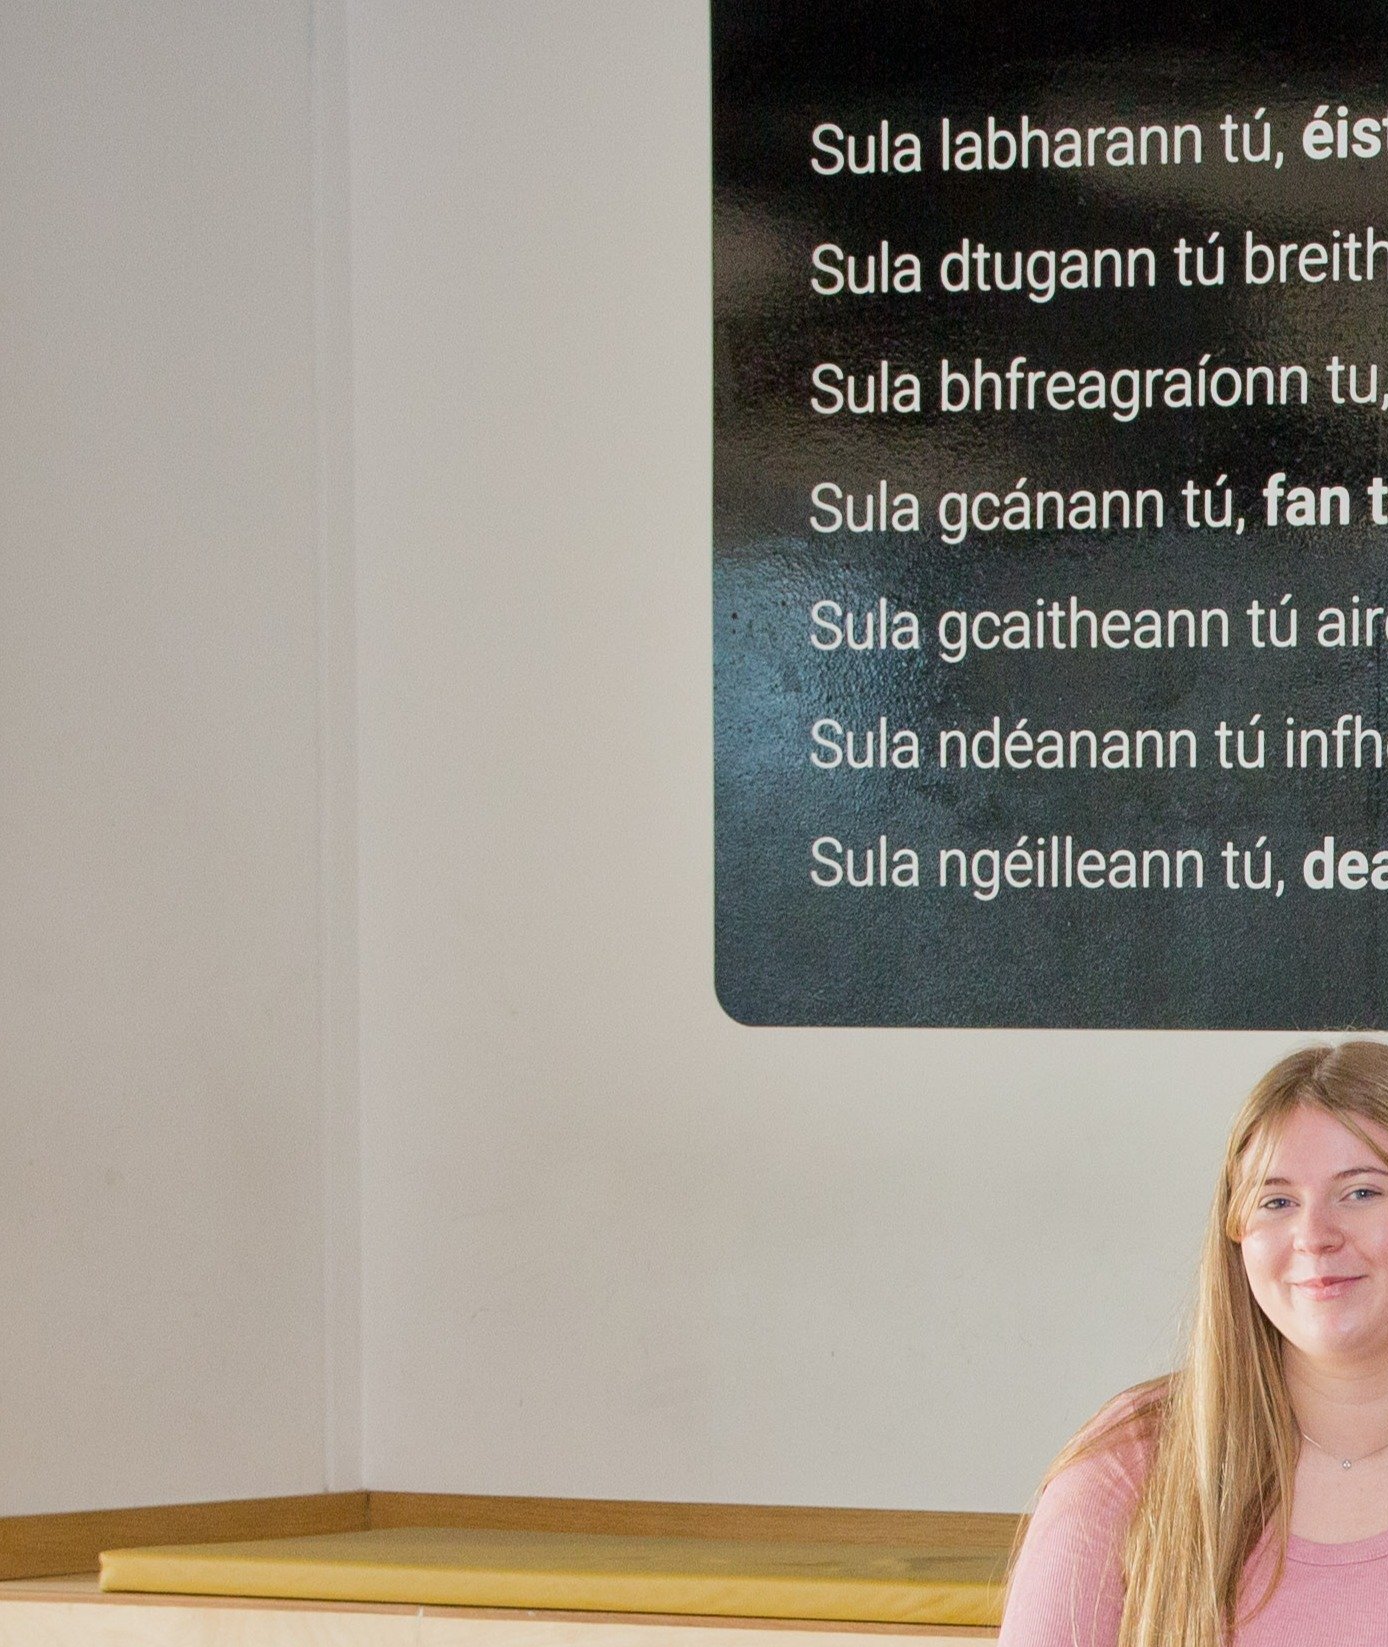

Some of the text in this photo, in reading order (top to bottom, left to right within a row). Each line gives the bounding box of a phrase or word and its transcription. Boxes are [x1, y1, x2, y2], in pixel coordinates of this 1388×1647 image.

[812, 120, 921, 174] Sula
[943, 116, 1201, 170] labharann
[1220, 108, 1283, 169] tú,
[812, 241, 920, 294] Sula
[941, 239, 1155, 302] dtugann
[1174, 239, 1224, 285] tú
[811, 361, 920, 414] Sula
[942, 357, 1307, 421] bhfreagraíonn
[811, 480, 919, 532] Sula
[939, 490, 1163, 544] gcánann
[1182, 481, 1244, 534] tú,
[1263, 473, 1349, 526] fan
[811, 598, 919, 652] Sula
[939, 596, 1228, 663] gcaitheann
[1247, 594, 1297, 647] tú
[810, 717, 919, 769] Sula
[940, 716, 1196, 768] ndéanann
[1215, 714, 1264, 769] tú
[811, 835, 919, 887] Sula
[940, 836, 1203, 901] ngéilleann
[1221, 842, 1284, 897] tú,
